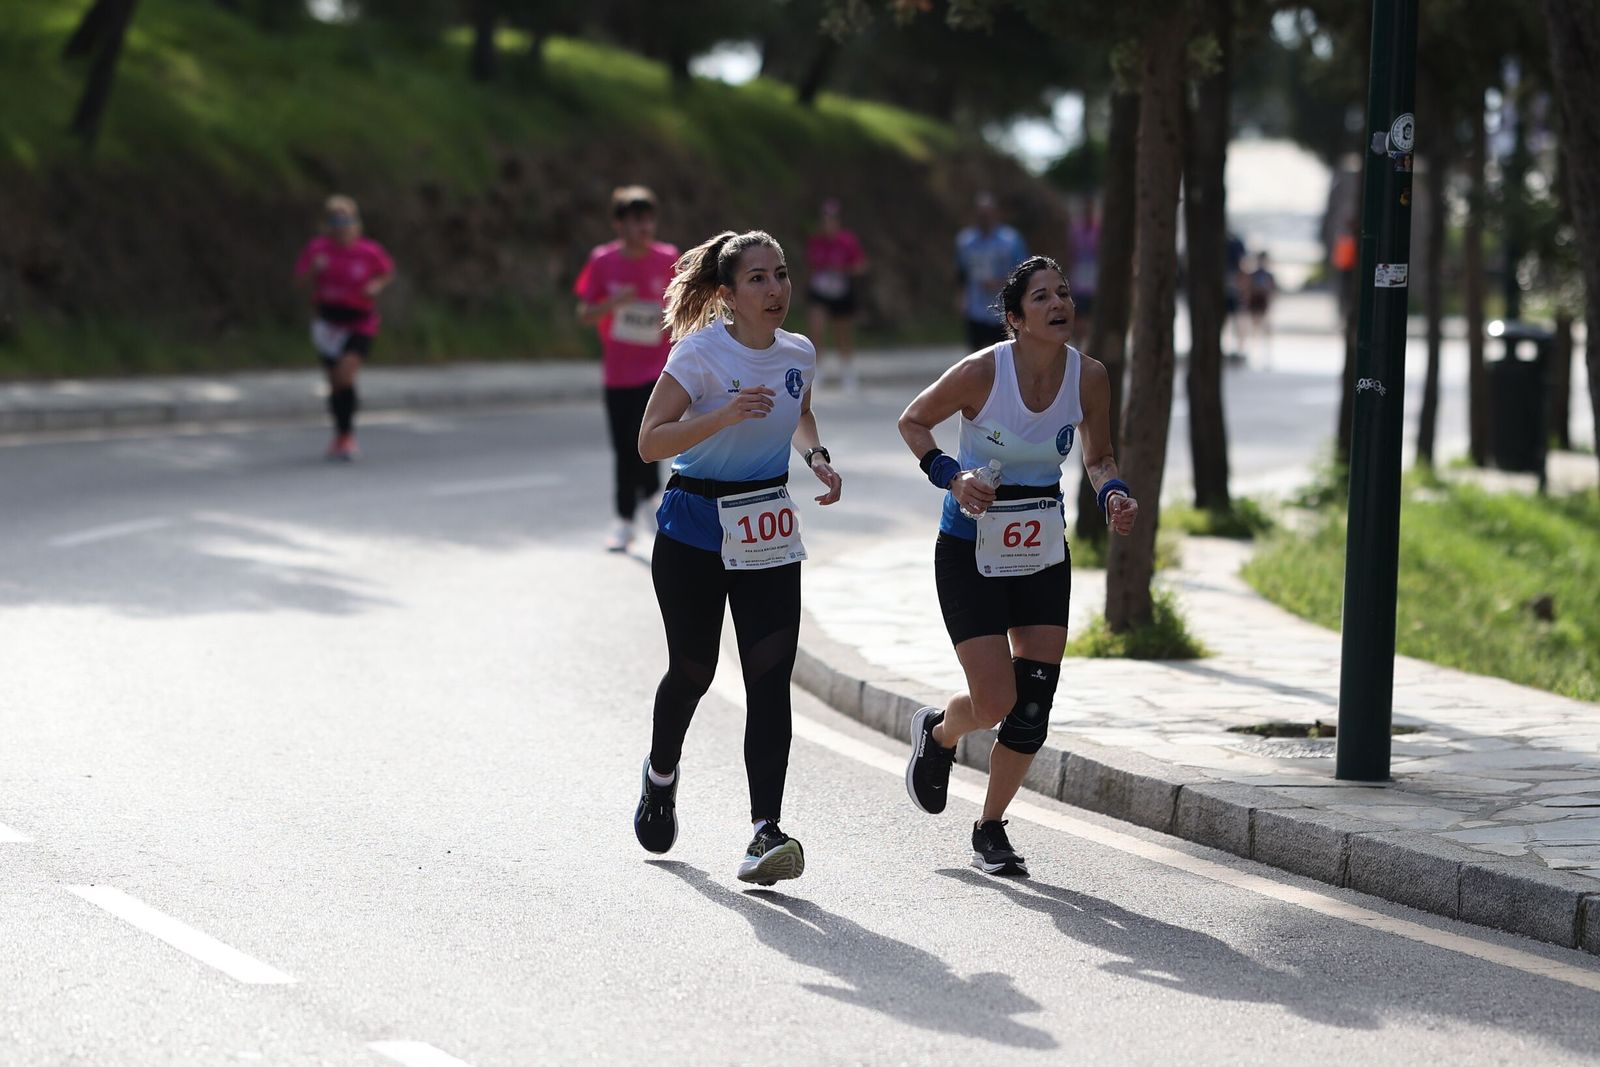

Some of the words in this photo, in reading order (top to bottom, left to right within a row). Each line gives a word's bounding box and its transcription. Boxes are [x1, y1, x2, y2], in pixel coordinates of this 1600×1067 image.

[737, 508, 794, 544] 100
[1003, 520, 1041, 548] 62
[918, 729, 928, 758] HOKA
